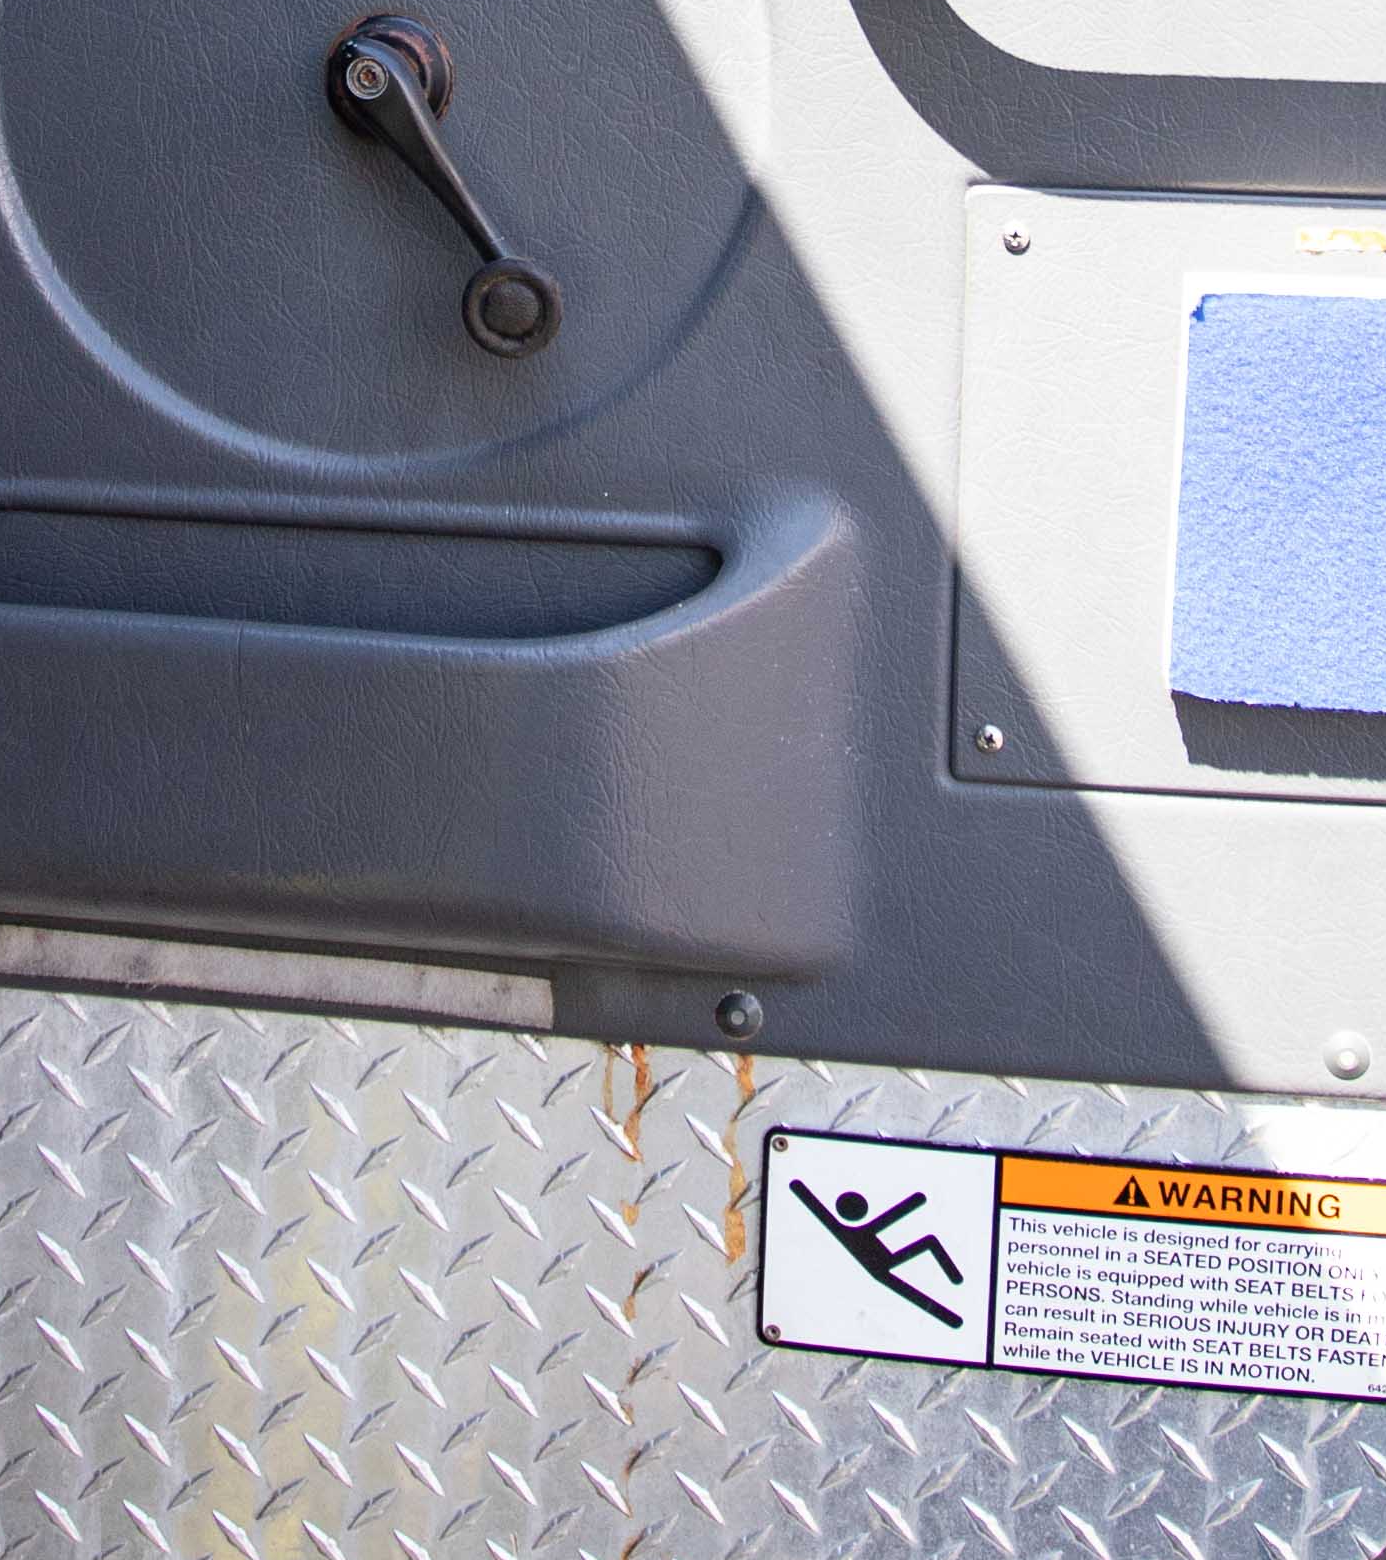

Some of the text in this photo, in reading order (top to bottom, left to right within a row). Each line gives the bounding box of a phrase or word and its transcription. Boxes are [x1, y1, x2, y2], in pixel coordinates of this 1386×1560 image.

[1160, 1181, 1342, 1219] WARNING
[1008, 1216, 1048, 1235] This
[1052, 1222, 1118, 1241] vehicle
[1123, 1226, 1139, 1243] is
[1143, 1228, 1230, 1251] designed
[1234, 1235, 1262, 1253] for
[1007, 1241, 1100, 1261] personnel
[1105, 1245, 1121, 1263] in
[1126, 1251, 1138, 1264] a
[1143, 1249, 1222, 1270] SEATED
[1227, 1256, 1323, 1279] POSITION
[1006, 1260, 1072, 1279] vehicle
[1076, 1264, 1092, 1281] is
[1096, 1269, 1185, 1290] equipped
[1189, 1275, 1229, 1293] with
[1233, 1277, 1286, 1297] SEAT
[1291, 1282, 1354, 1302] BELTS
[1006, 1279, 1106, 1304] PERSONS.
[1111, 1288, 1194, 1314] Standing
[1199, 1297, 1249, 1315] while
[1253, 1301, 1320, 1321] vehicle
[1324, 1306, 1340, 1323] is
[1345, 1311, 1362, 1324] in
[1004, 1303, 1038, 1318] can
[1043, 1307, 1096, 1324] result
[1101, 1308, 1117, 1326] in
[1122, 1311, 1212, 1333] SERIOUS
[1216, 1319, 1291, 1339] INJURY
[1294, 1324, 1325, 1343] OR
[1004, 1320, 1074, 1343] Remain
[1079, 1331, 1143, 1349] seated
[1147, 1335, 1187, 1353] with
[1191, 1337, 1245, 1357] SEAT
[1248, 1342, 1312, 1363] BELTS
[1003, 1343, 1316, 1384] while the VEHICLE IS IN MOTION.
